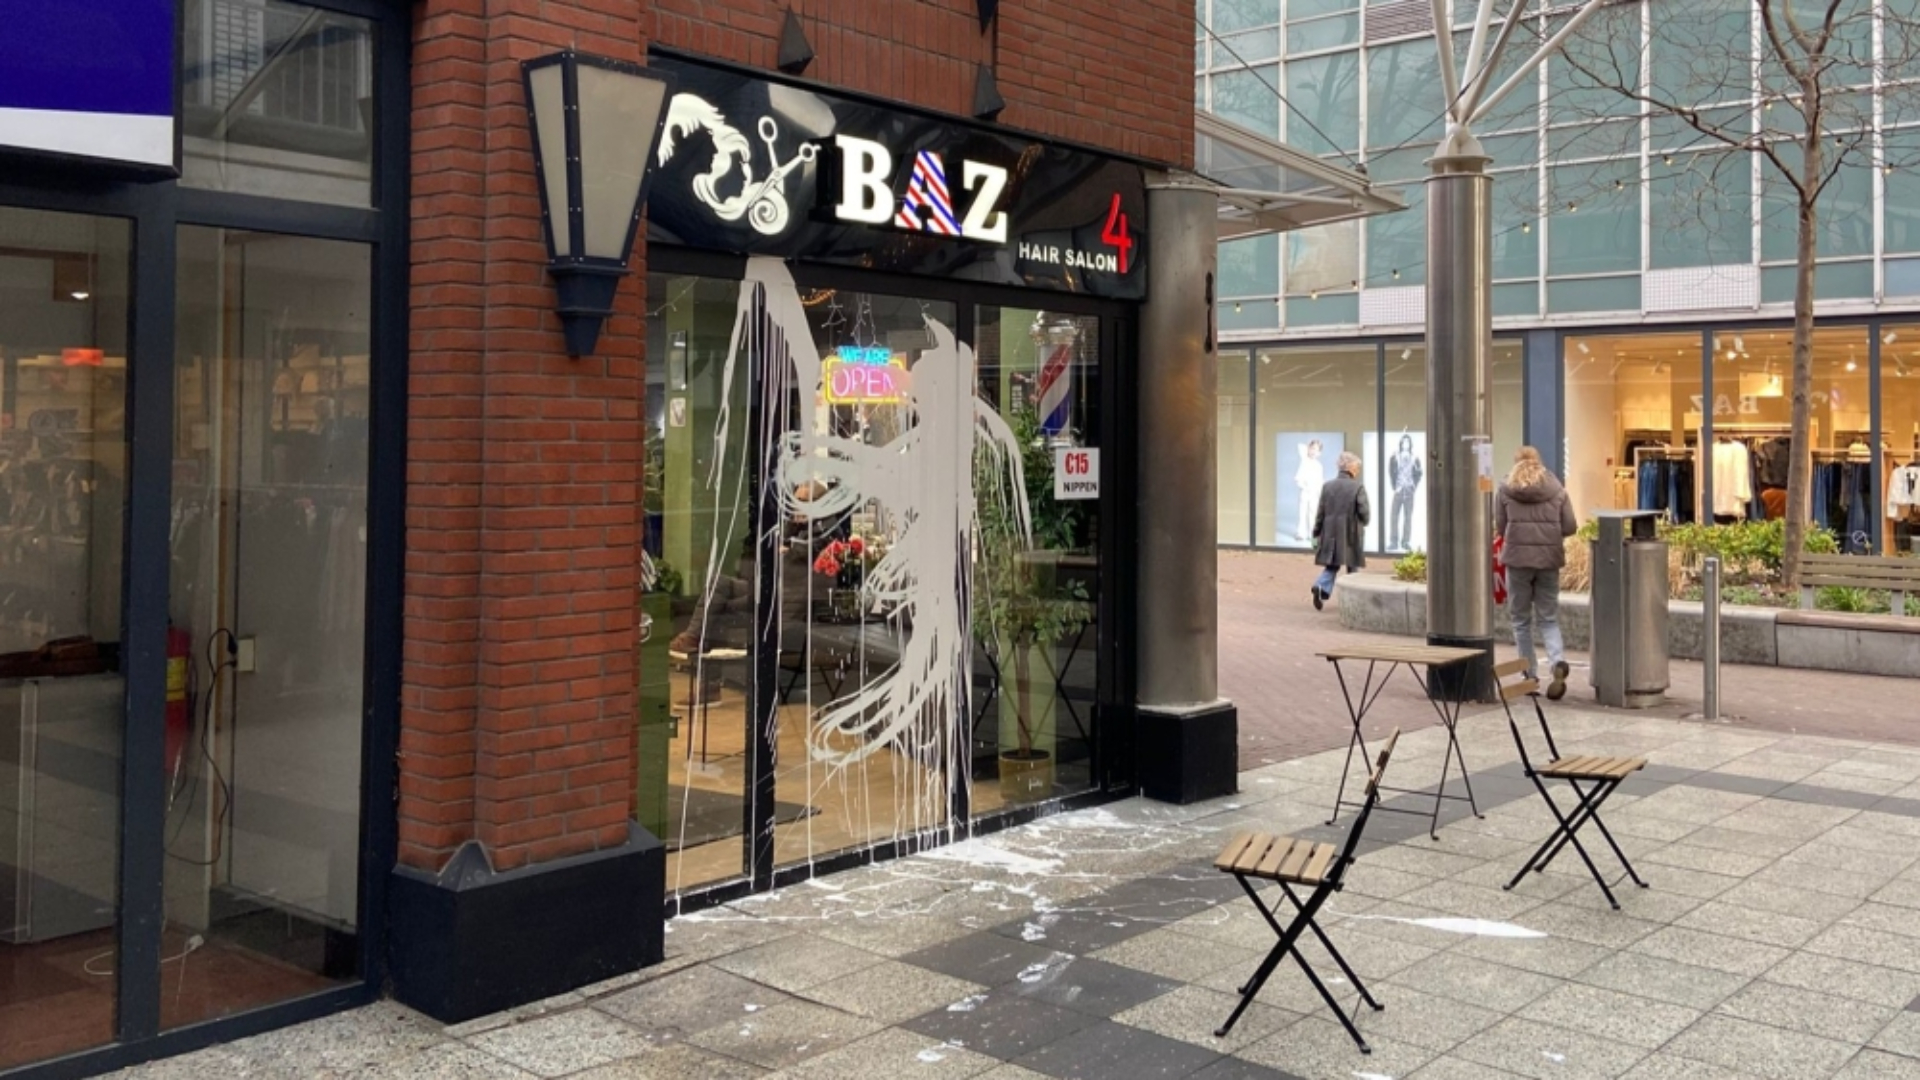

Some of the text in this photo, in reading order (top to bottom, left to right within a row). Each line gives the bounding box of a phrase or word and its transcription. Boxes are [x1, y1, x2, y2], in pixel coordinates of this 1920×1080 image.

[835, 133, 1008, 243] BAZ
[1018, 242, 1118, 273] HAIR SALON
[1101, 192, 1133, 274] 4
[838, 345, 891, 366] WE ARE
